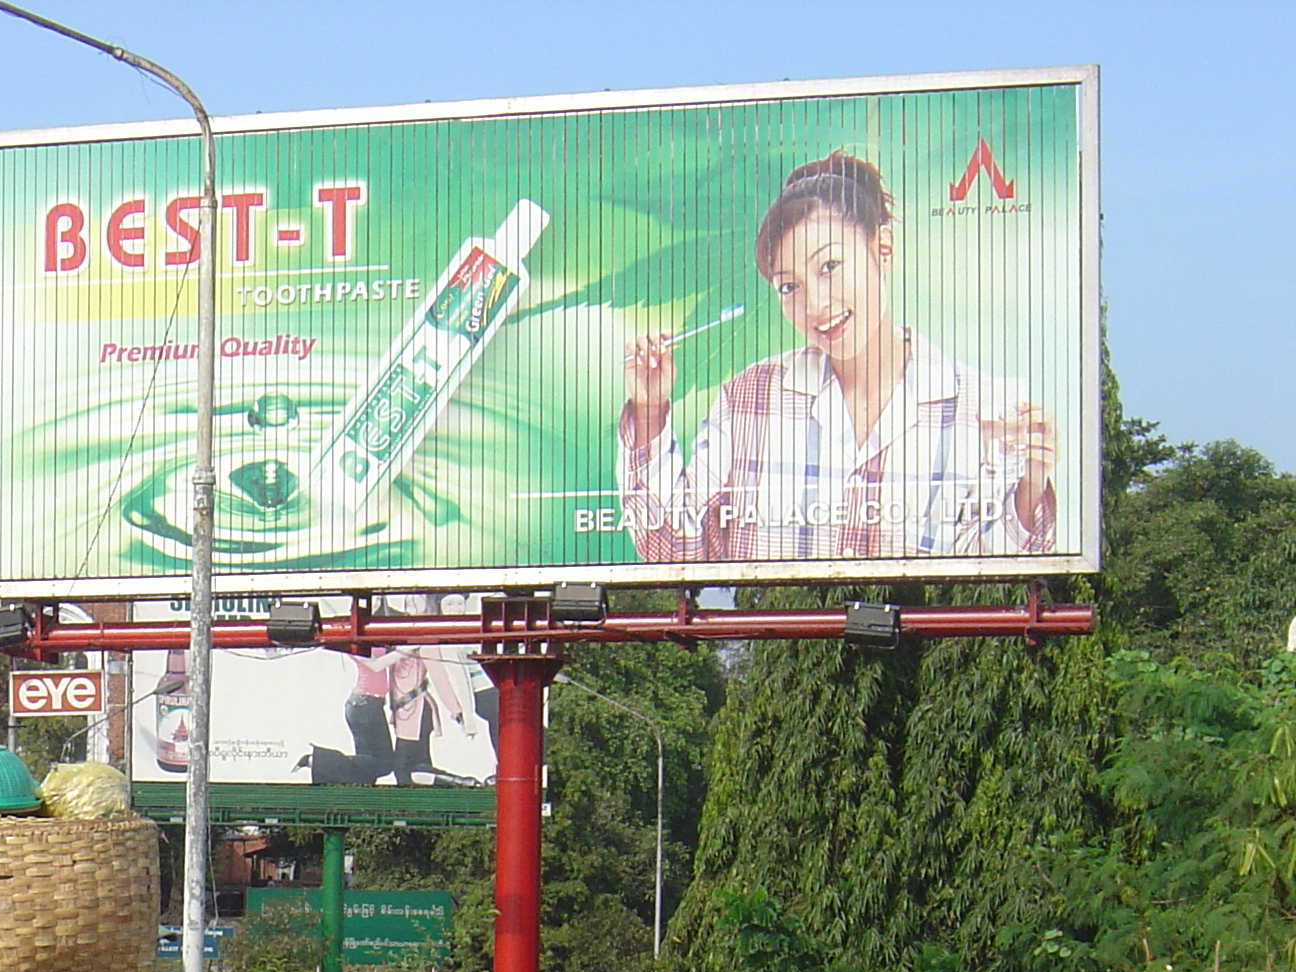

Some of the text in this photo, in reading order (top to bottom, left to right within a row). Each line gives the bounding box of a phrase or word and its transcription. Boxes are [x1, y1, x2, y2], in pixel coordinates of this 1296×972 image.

[931, 203, 1033, 217] BEAUTY PALACE
[44, 186, 362, 273] BEST-T
[236, 279, 421, 307] TOOTHPASTE
[465, 291, 485, 333] Green
[220, 334, 316, 361] Quality
[574, 504, 709, 534] BEAUTY
[719, 501, 850, 530] PALACE
